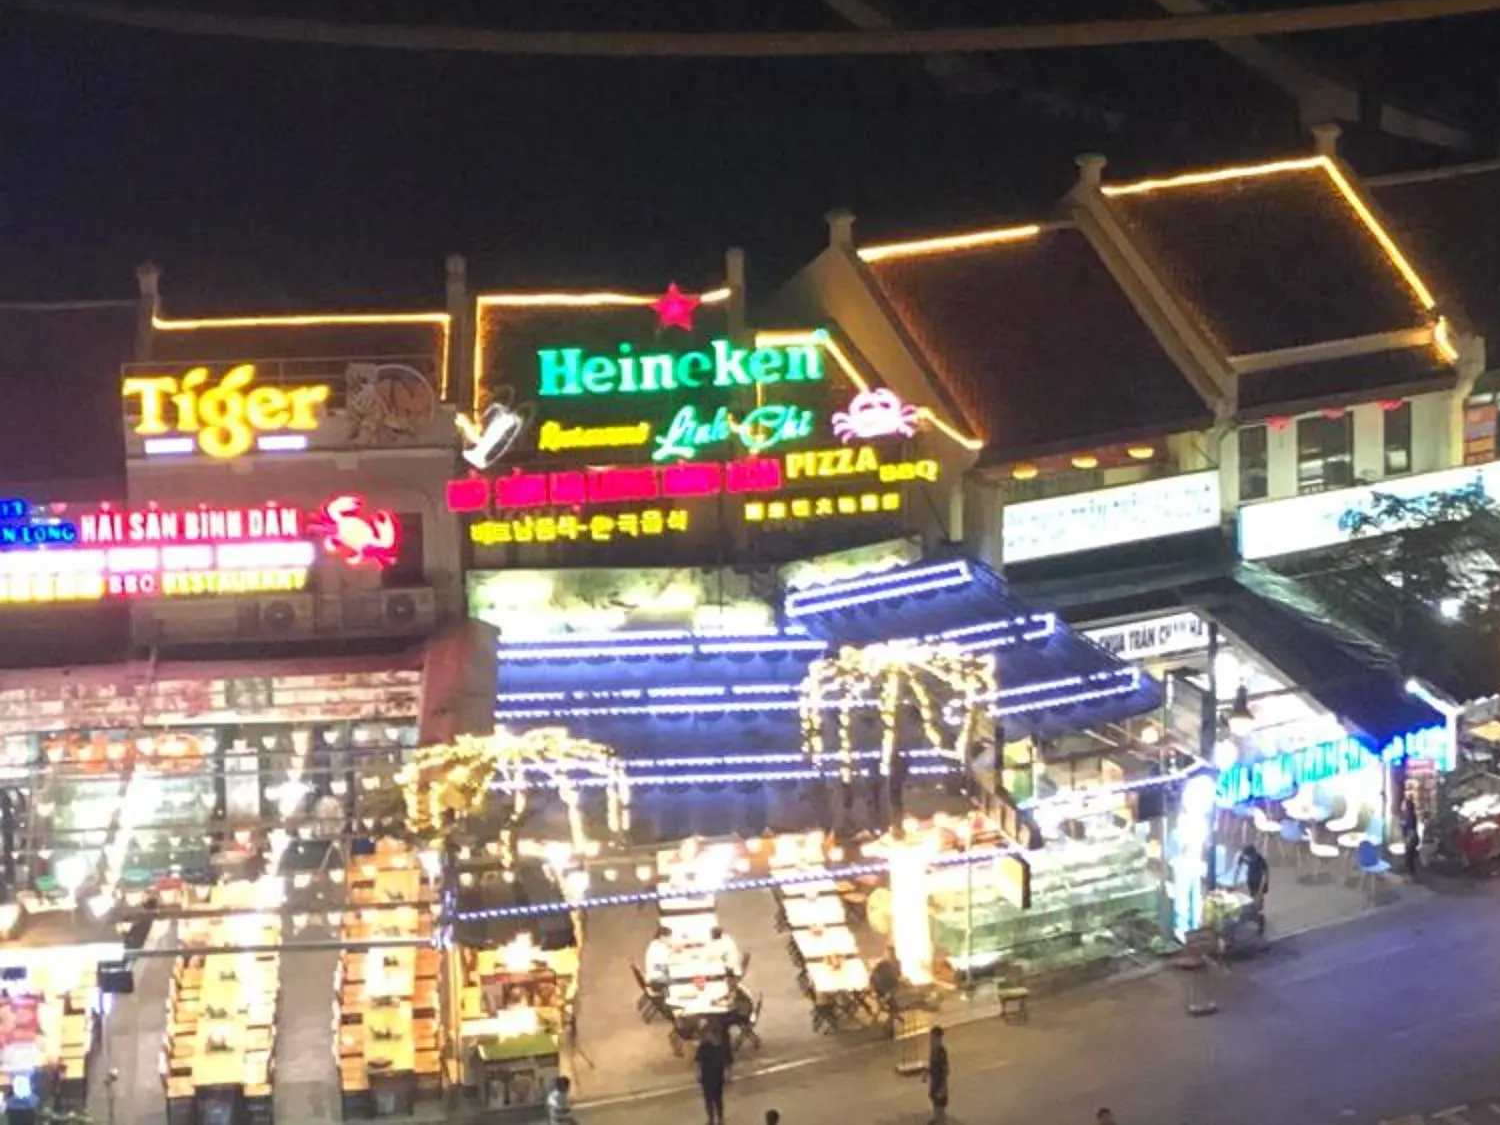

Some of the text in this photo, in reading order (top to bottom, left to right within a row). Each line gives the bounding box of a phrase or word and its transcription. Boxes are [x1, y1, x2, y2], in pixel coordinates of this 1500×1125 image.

[537, 339, 823, 396] Heineken
[122, 365, 330, 458] Tiger
[785, 446, 878, 479] PIZZA
